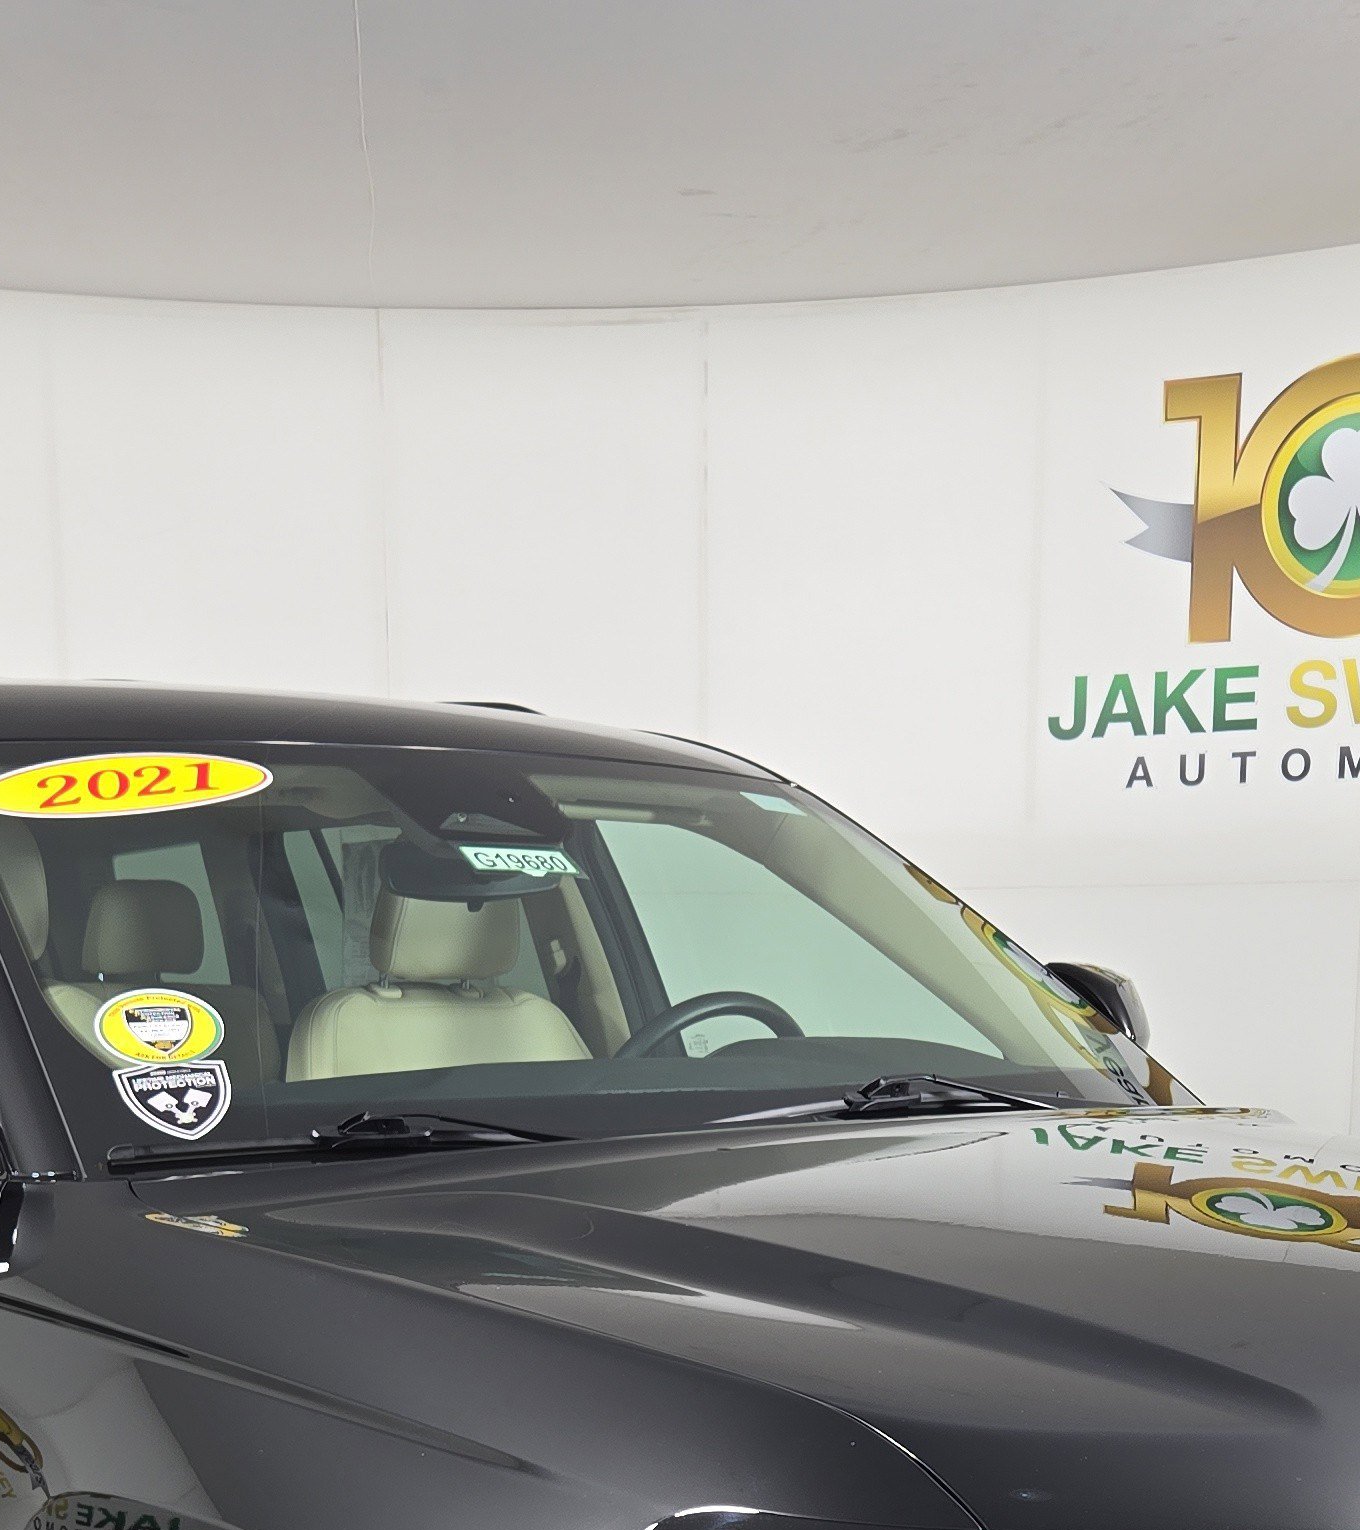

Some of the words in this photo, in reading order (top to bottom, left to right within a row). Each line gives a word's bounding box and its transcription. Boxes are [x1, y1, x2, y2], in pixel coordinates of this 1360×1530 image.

[1047, 665, 1260, 741] JAKE
[36, 762, 220, 809] 2021
[473, 852, 568, 872] G19680
